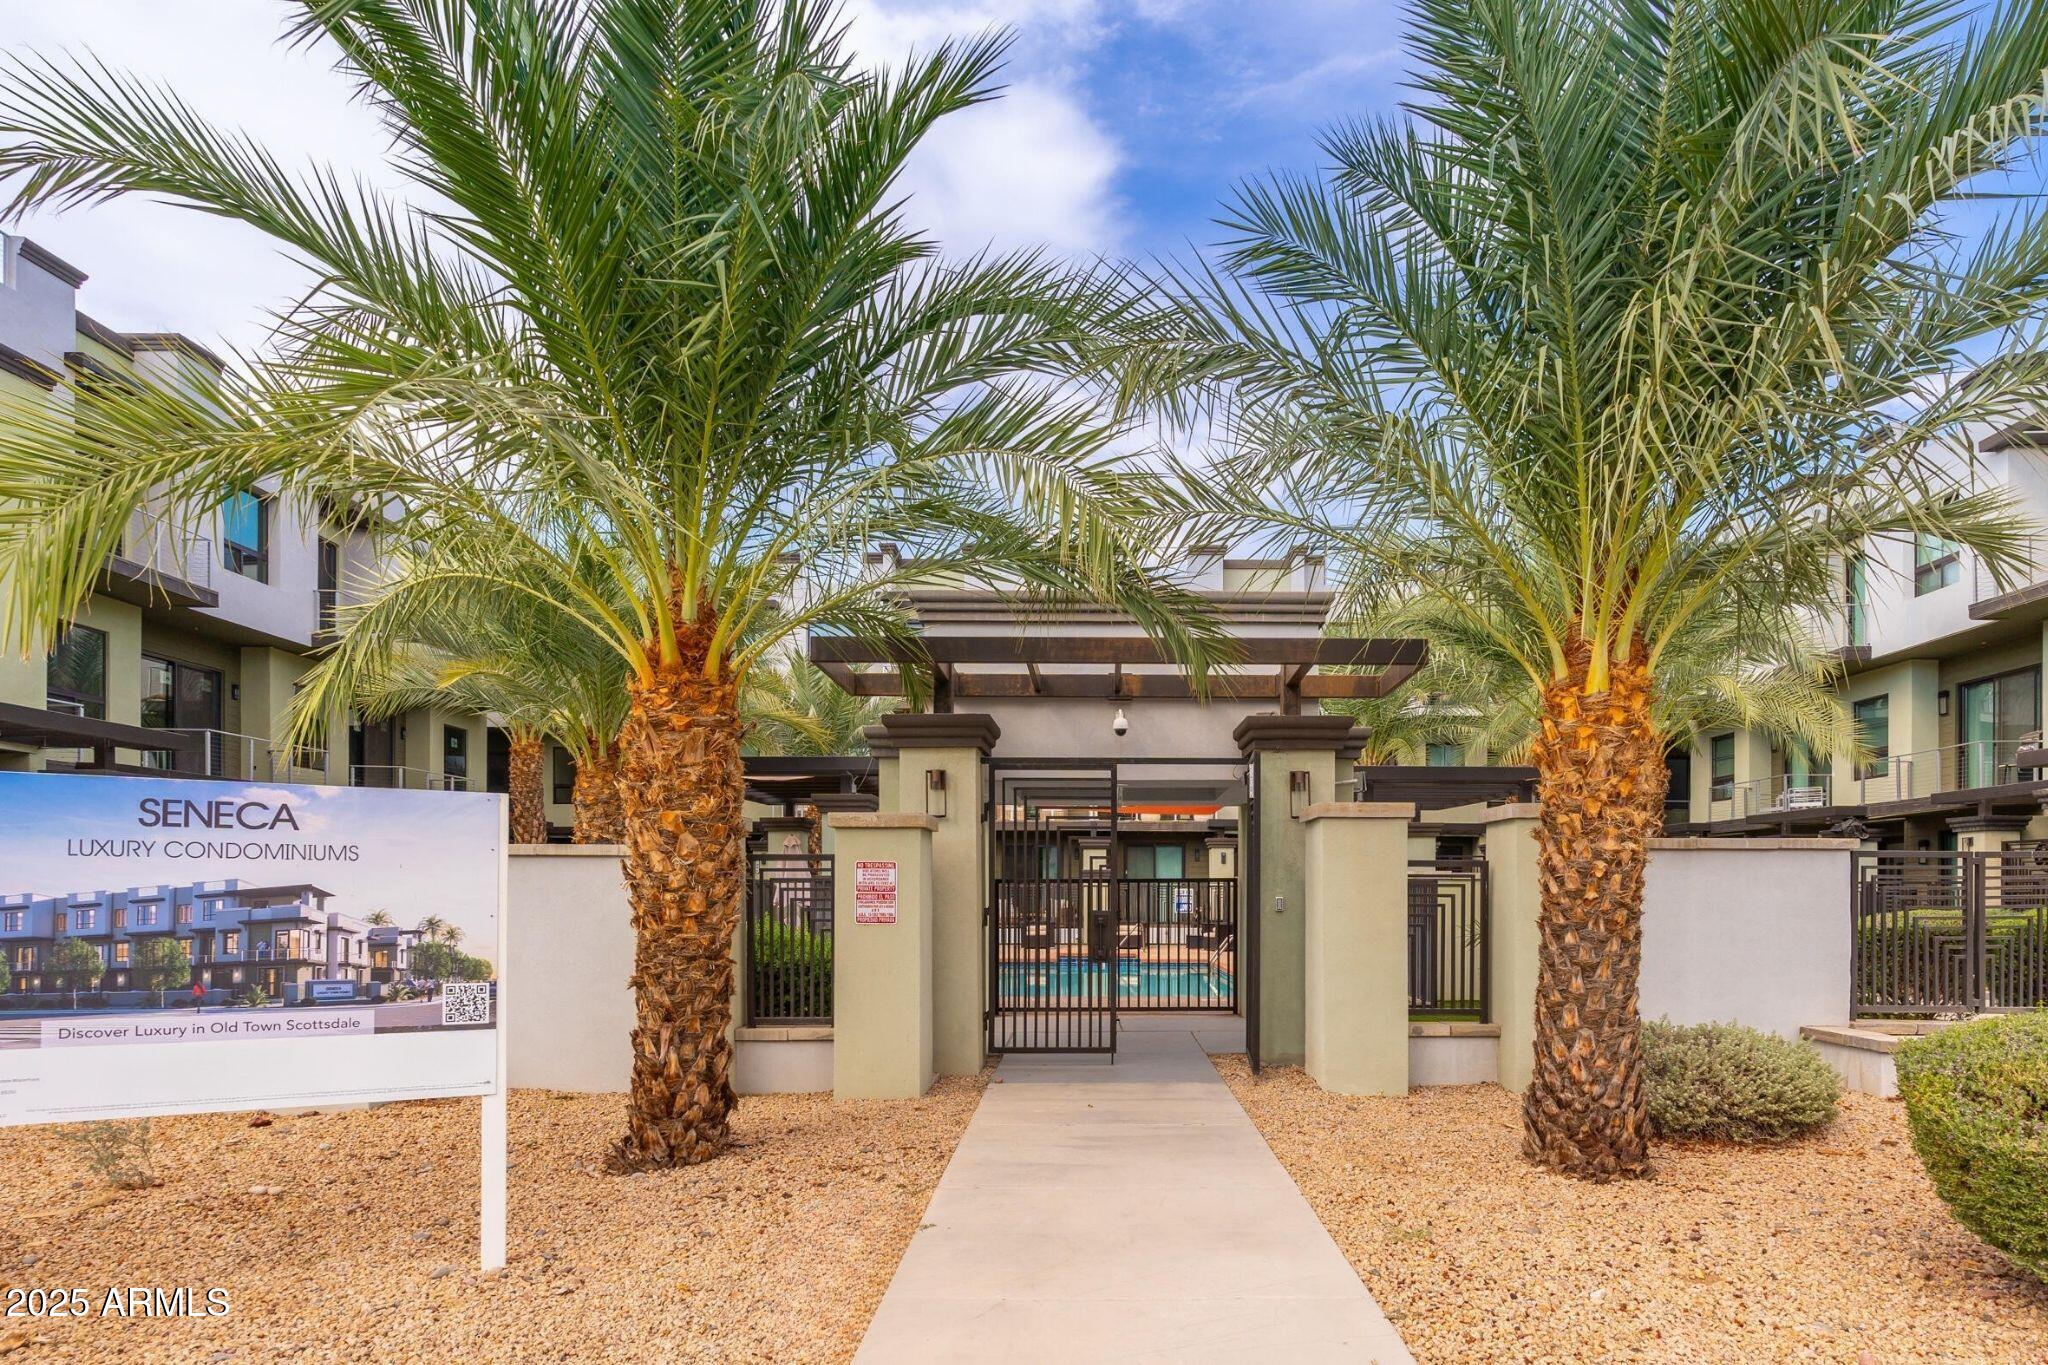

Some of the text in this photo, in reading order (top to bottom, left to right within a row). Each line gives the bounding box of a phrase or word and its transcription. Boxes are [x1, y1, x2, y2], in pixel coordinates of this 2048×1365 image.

[138, 798, 300, 831] SENECA
[67, 838, 359, 862] LUXURY CONDOMINIUMS
[58, 1017, 361, 1040] Discover Luxury in Old Town Scottsdale
